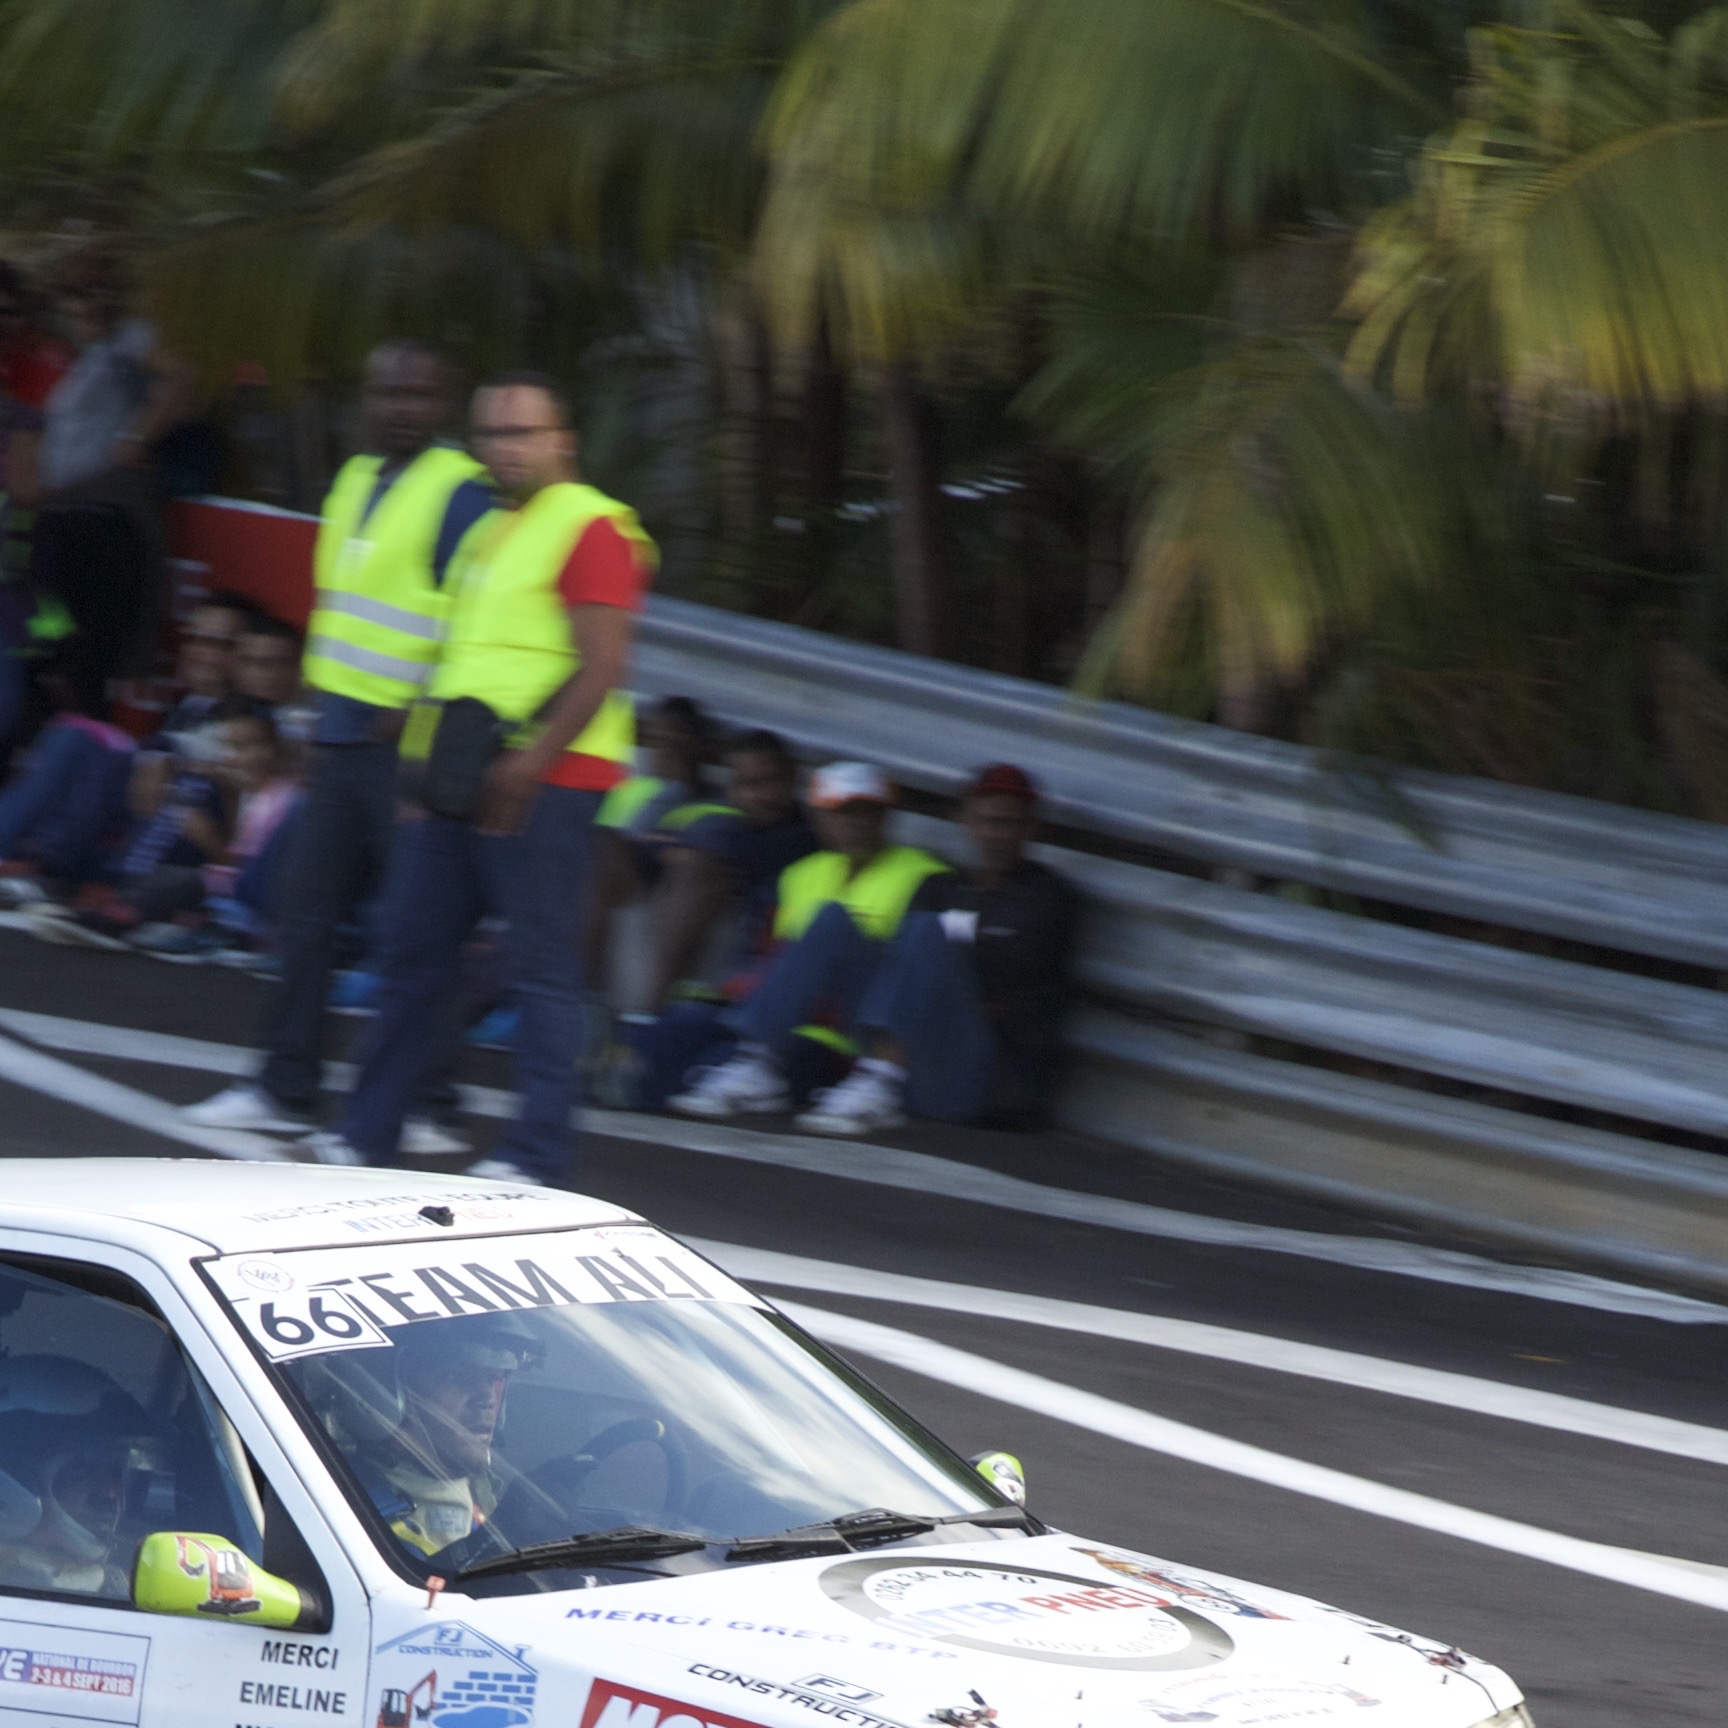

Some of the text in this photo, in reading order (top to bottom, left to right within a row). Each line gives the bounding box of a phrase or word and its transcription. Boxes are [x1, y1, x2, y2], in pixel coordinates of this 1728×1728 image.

[307, 1258, 582, 1328] TEAM
[259, 1296, 363, 1346] 66
[873, 1586, 1171, 1638] INTER PNEU
[437, 1628, 464, 1644] FJ
[564, 1607, 960, 1660] MERCI GREG BTP
[260, 1640, 339, 1670] MERCI
[398, 1644, 493, 1659] CONSTRUCTION
[31, 1666, 52, 1685] 2-3
[62, 1670, 72, 1687] 4
[72, 1672, 101, 1691] SEPT
[101, 1676, 132, 1696] 2016
[805, 1676, 876, 1702] FJ
[239, 1680, 346, 1715] EMELINE
